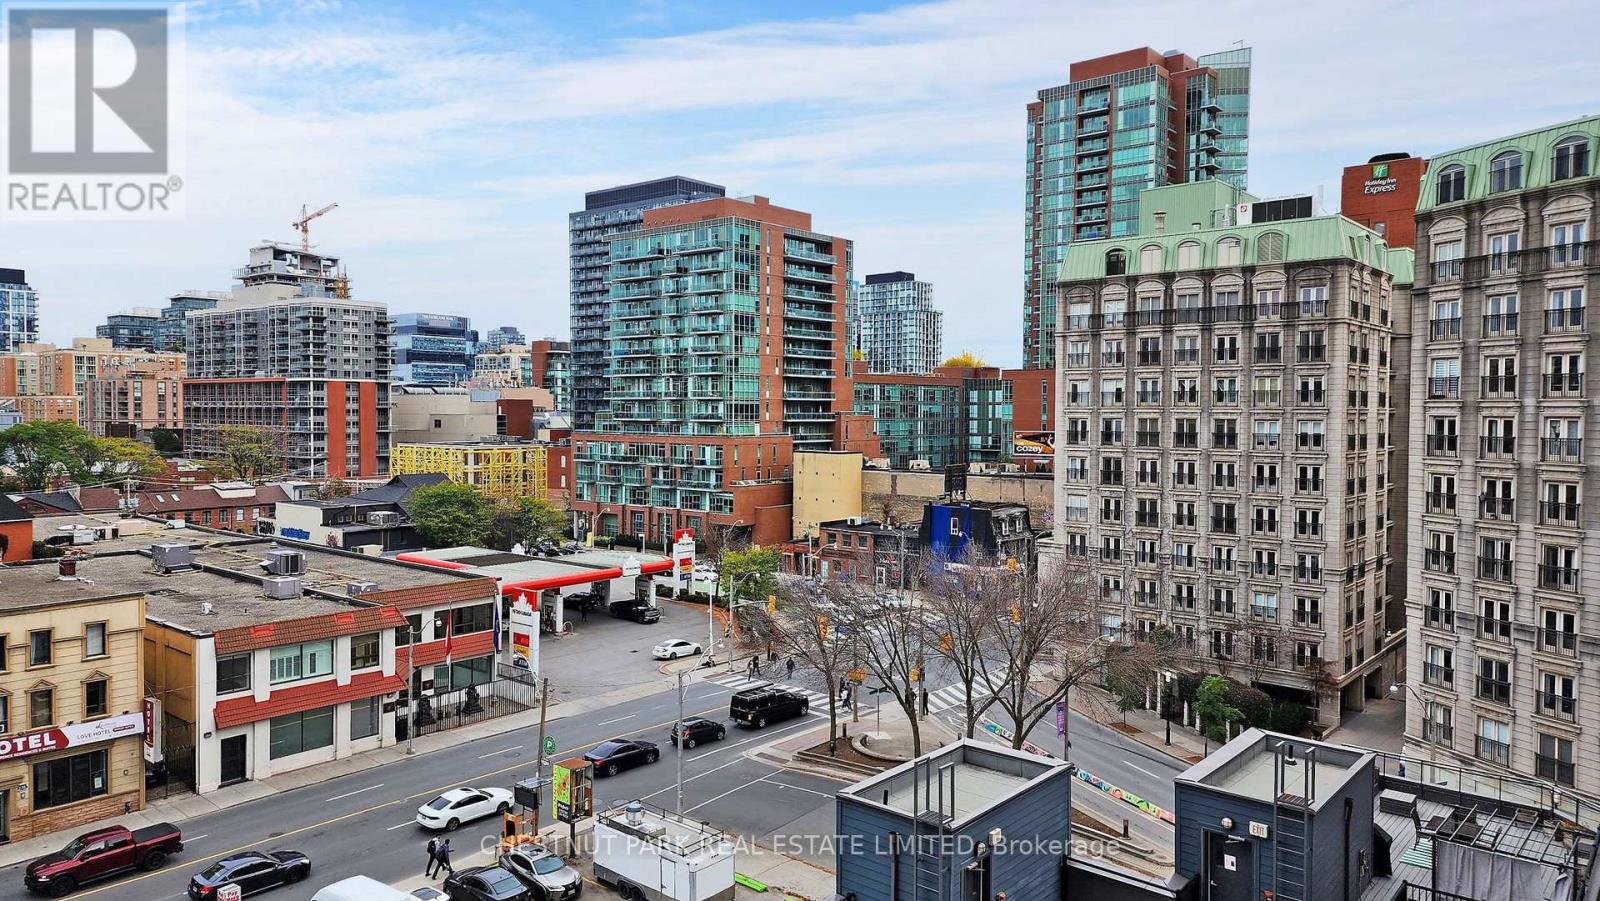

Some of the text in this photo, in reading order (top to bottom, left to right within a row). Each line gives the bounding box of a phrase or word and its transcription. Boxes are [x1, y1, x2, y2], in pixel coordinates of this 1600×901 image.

[1364, 184, 1396, 194] Express
[1016, 445, 1043, 453] cozey
[1253, 825, 1265, 836] EXIT
